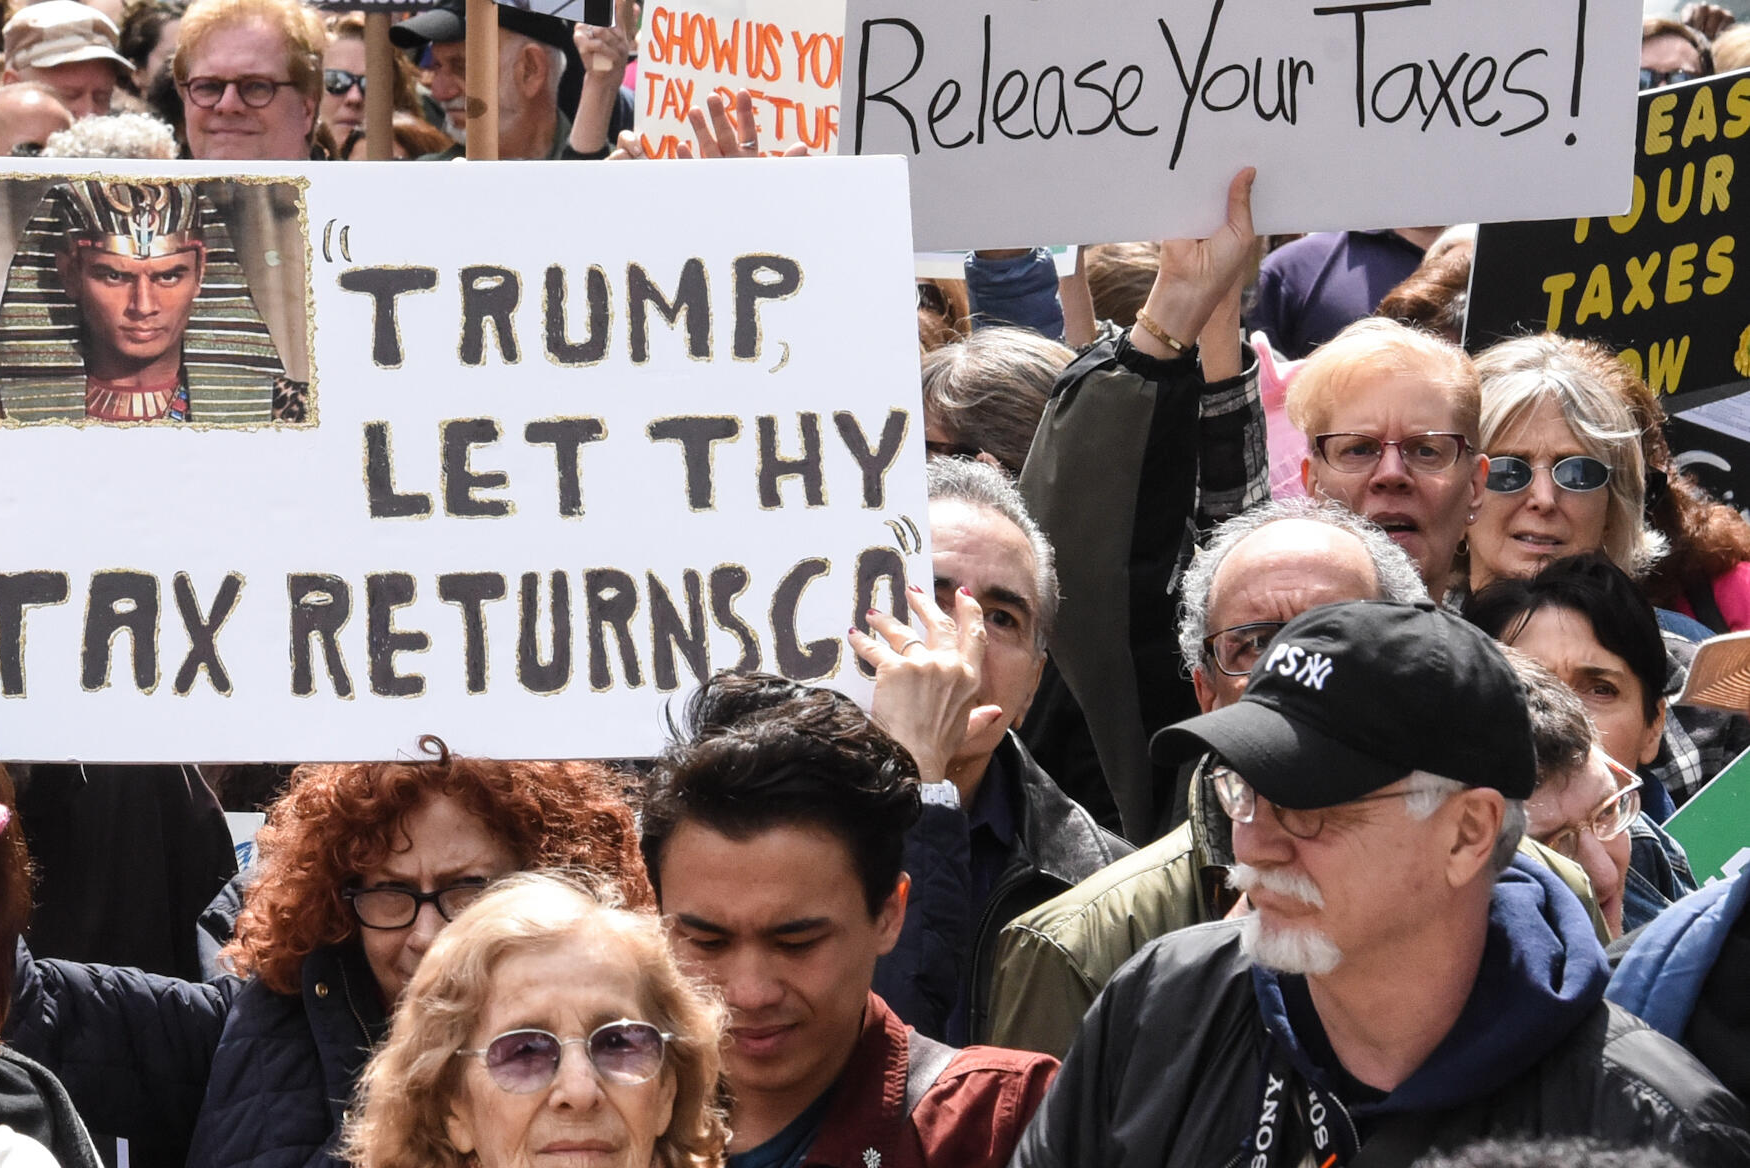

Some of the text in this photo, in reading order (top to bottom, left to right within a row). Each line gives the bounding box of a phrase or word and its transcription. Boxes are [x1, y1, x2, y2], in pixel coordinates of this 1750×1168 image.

[647, 6, 740, 77] SHOW
[745, 20, 784, 82] US
[855, 13, 1159, 155] Release
[1541, 234, 1736, 332] TAXES
[362, 408, 910, 520] LET THY
[285, 560, 762, 701] RETURNS
[1251, 1072, 1285, 1168] SONY
